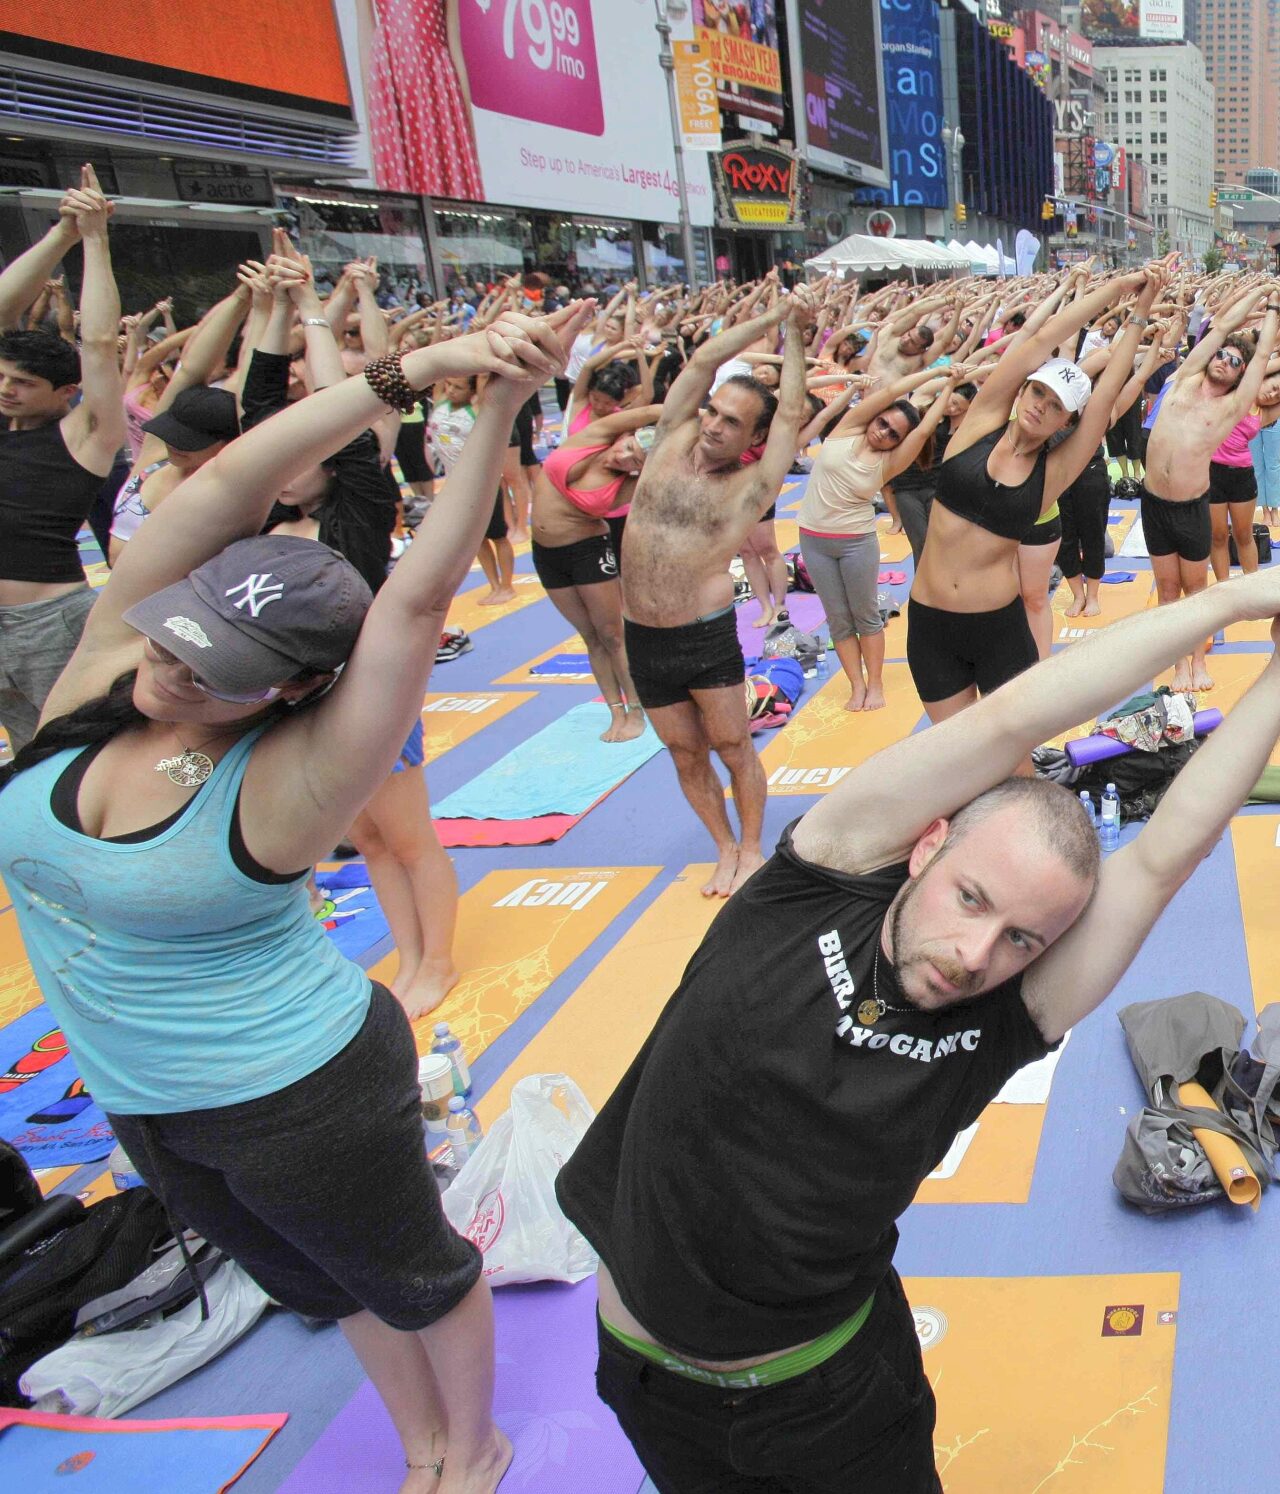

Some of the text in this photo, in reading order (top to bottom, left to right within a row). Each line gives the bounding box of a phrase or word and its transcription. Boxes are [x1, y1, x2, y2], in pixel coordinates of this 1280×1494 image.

[881, 42, 906, 54] organ
[556, 46, 586, 80] /mo
[721, 62, 779, 90] BROADWAY
[692, 59, 716, 116] YOGA
[520, 147, 546, 169] Step
[550, 159, 562, 175] up
[565, 159, 576, 174] to
[578, 160, 620, 181] America's
[621, 163, 662, 190] Largest
[206, 181, 254, 199] aerie
[739, 206, 786, 219] DELICATESSEN
[224, 572, 285, 618] NY
[424, 696, 500, 714] lucy
[767, 765, 855, 787] lucy
[490, 878, 609, 911] lucy
